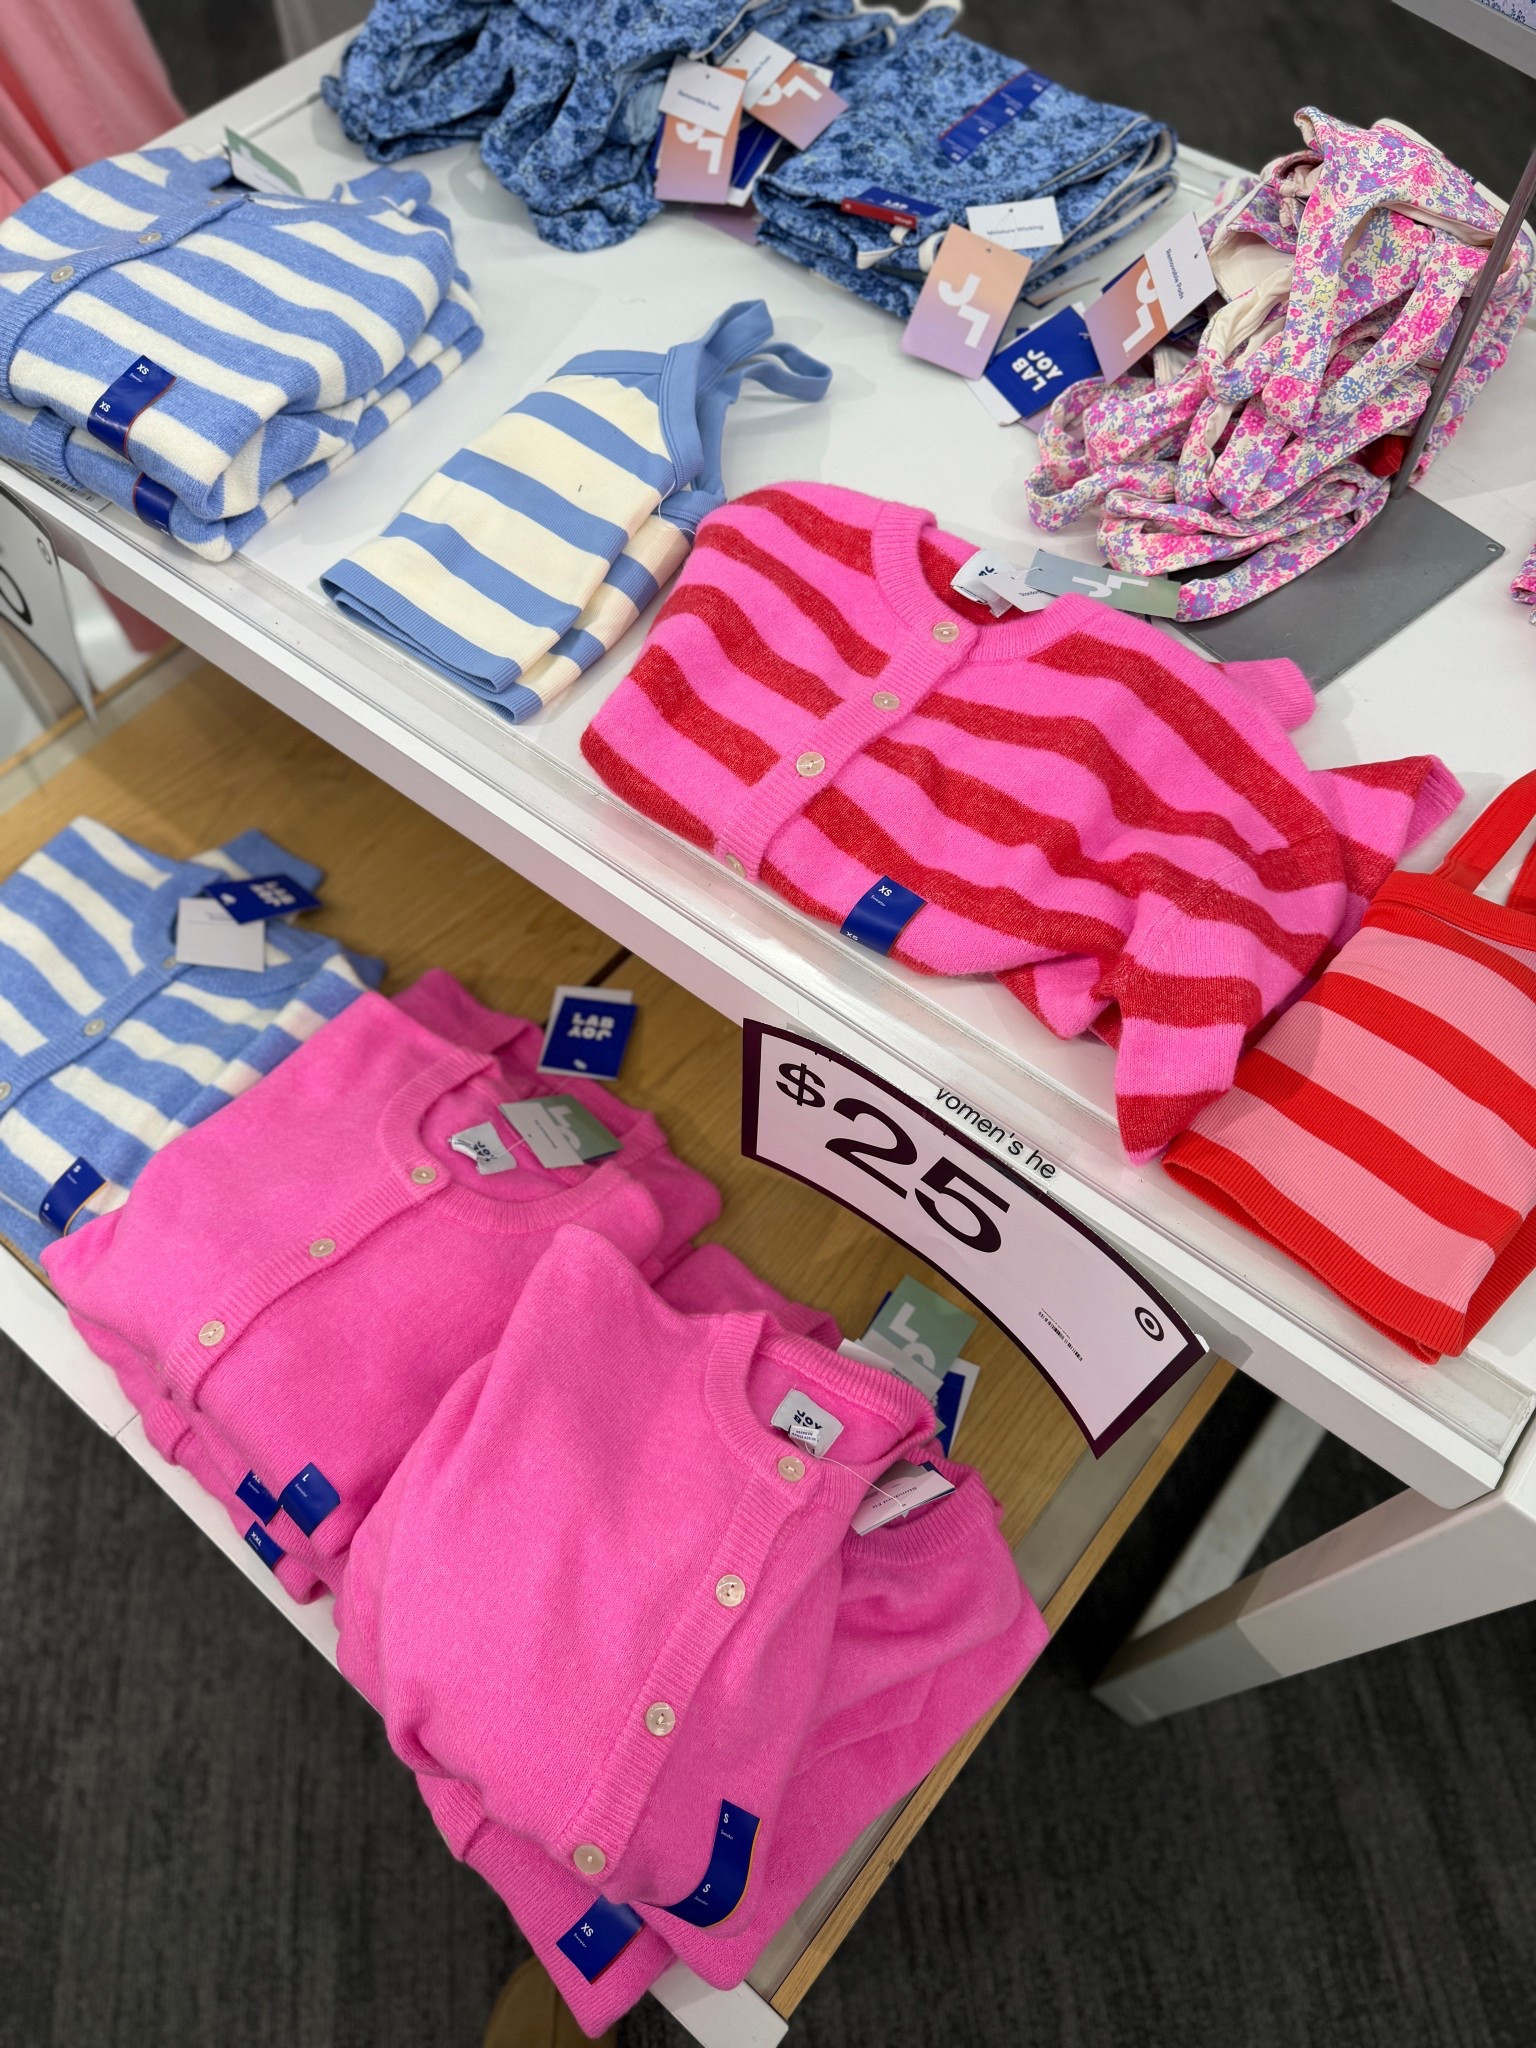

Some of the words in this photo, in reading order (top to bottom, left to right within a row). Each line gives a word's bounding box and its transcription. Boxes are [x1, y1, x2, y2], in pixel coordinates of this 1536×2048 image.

[1166, 248, 1179, 284] Removable
[1176, 282, 1185, 300] Pads
[136, 363, 150, 376] XS
[1026, 349, 1064, 380] JOY
[1011, 357, 1048, 393] LAB
[99, 401, 112, 413] XS
[878, 885, 893, 897] XS
[572, 1012, 615, 1030] LAB
[776, 1062, 1011, 1254] $25
[1025, 1149, 1056, 1179] he
[302, 1473, 310, 1482] L
[723, 1812, 730, 1824] S
[702, 1883, 711, 1893] S
[581, 1922, 594, 1937] XS
